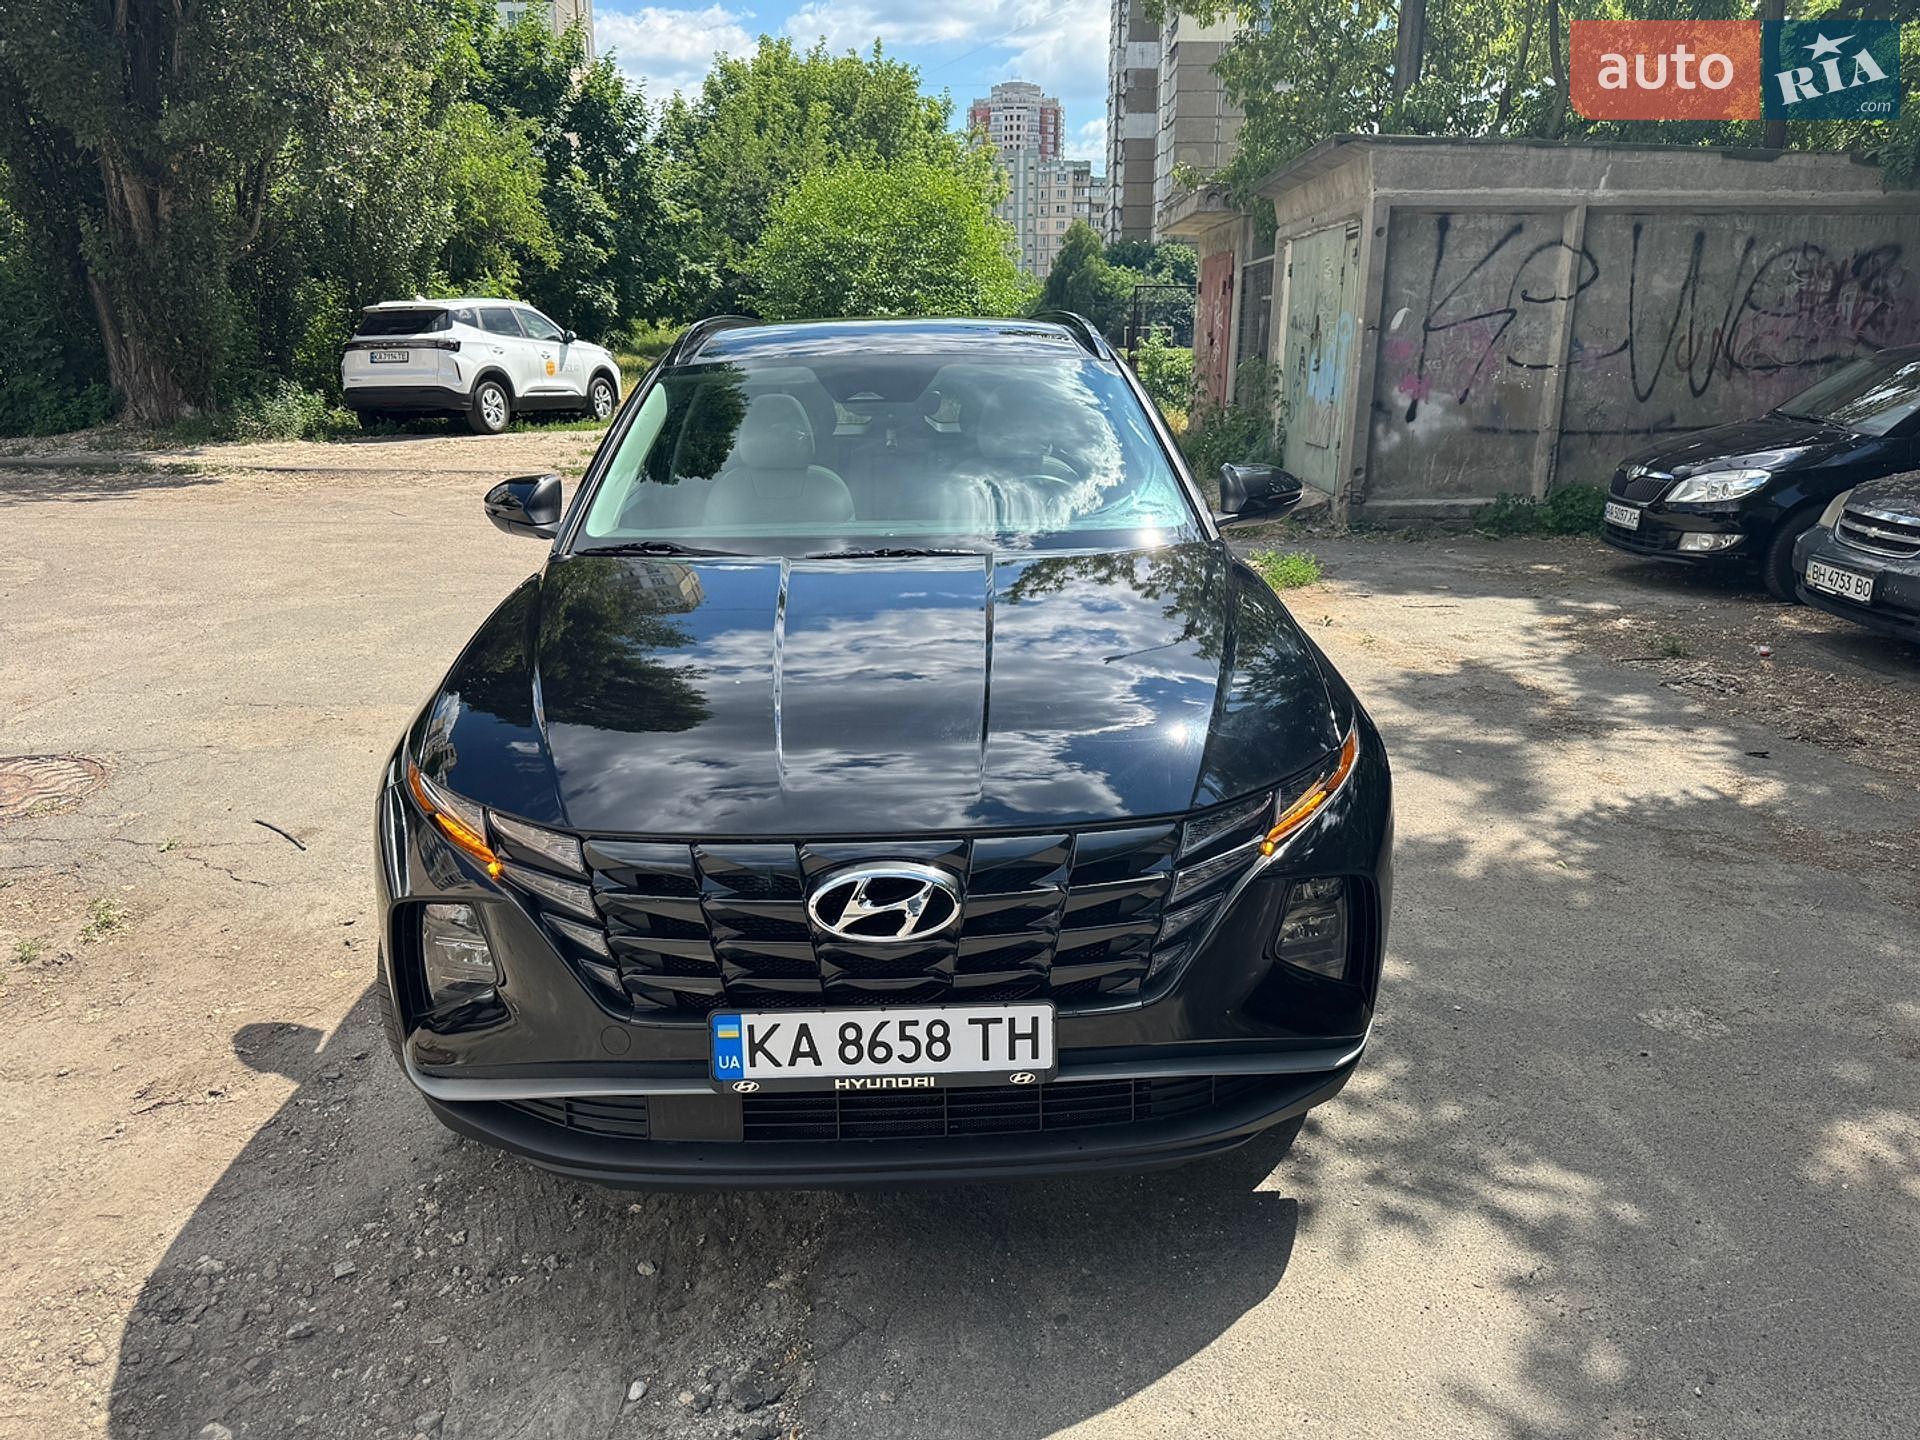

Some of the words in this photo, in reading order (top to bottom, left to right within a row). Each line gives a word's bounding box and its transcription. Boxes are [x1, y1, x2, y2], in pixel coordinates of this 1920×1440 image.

[1811, 564, 1827, 583] BH
[1828, 569, 1852, 591] 4753
[747, 1023, 823, 1068] KA
[838, 1019, 951, 1064] 8658
[967, 1016, 1040, 1061] TH
[718, 1055, 740, 1069] UA
[835, 1076, 935, 1090] HYUNDAI
